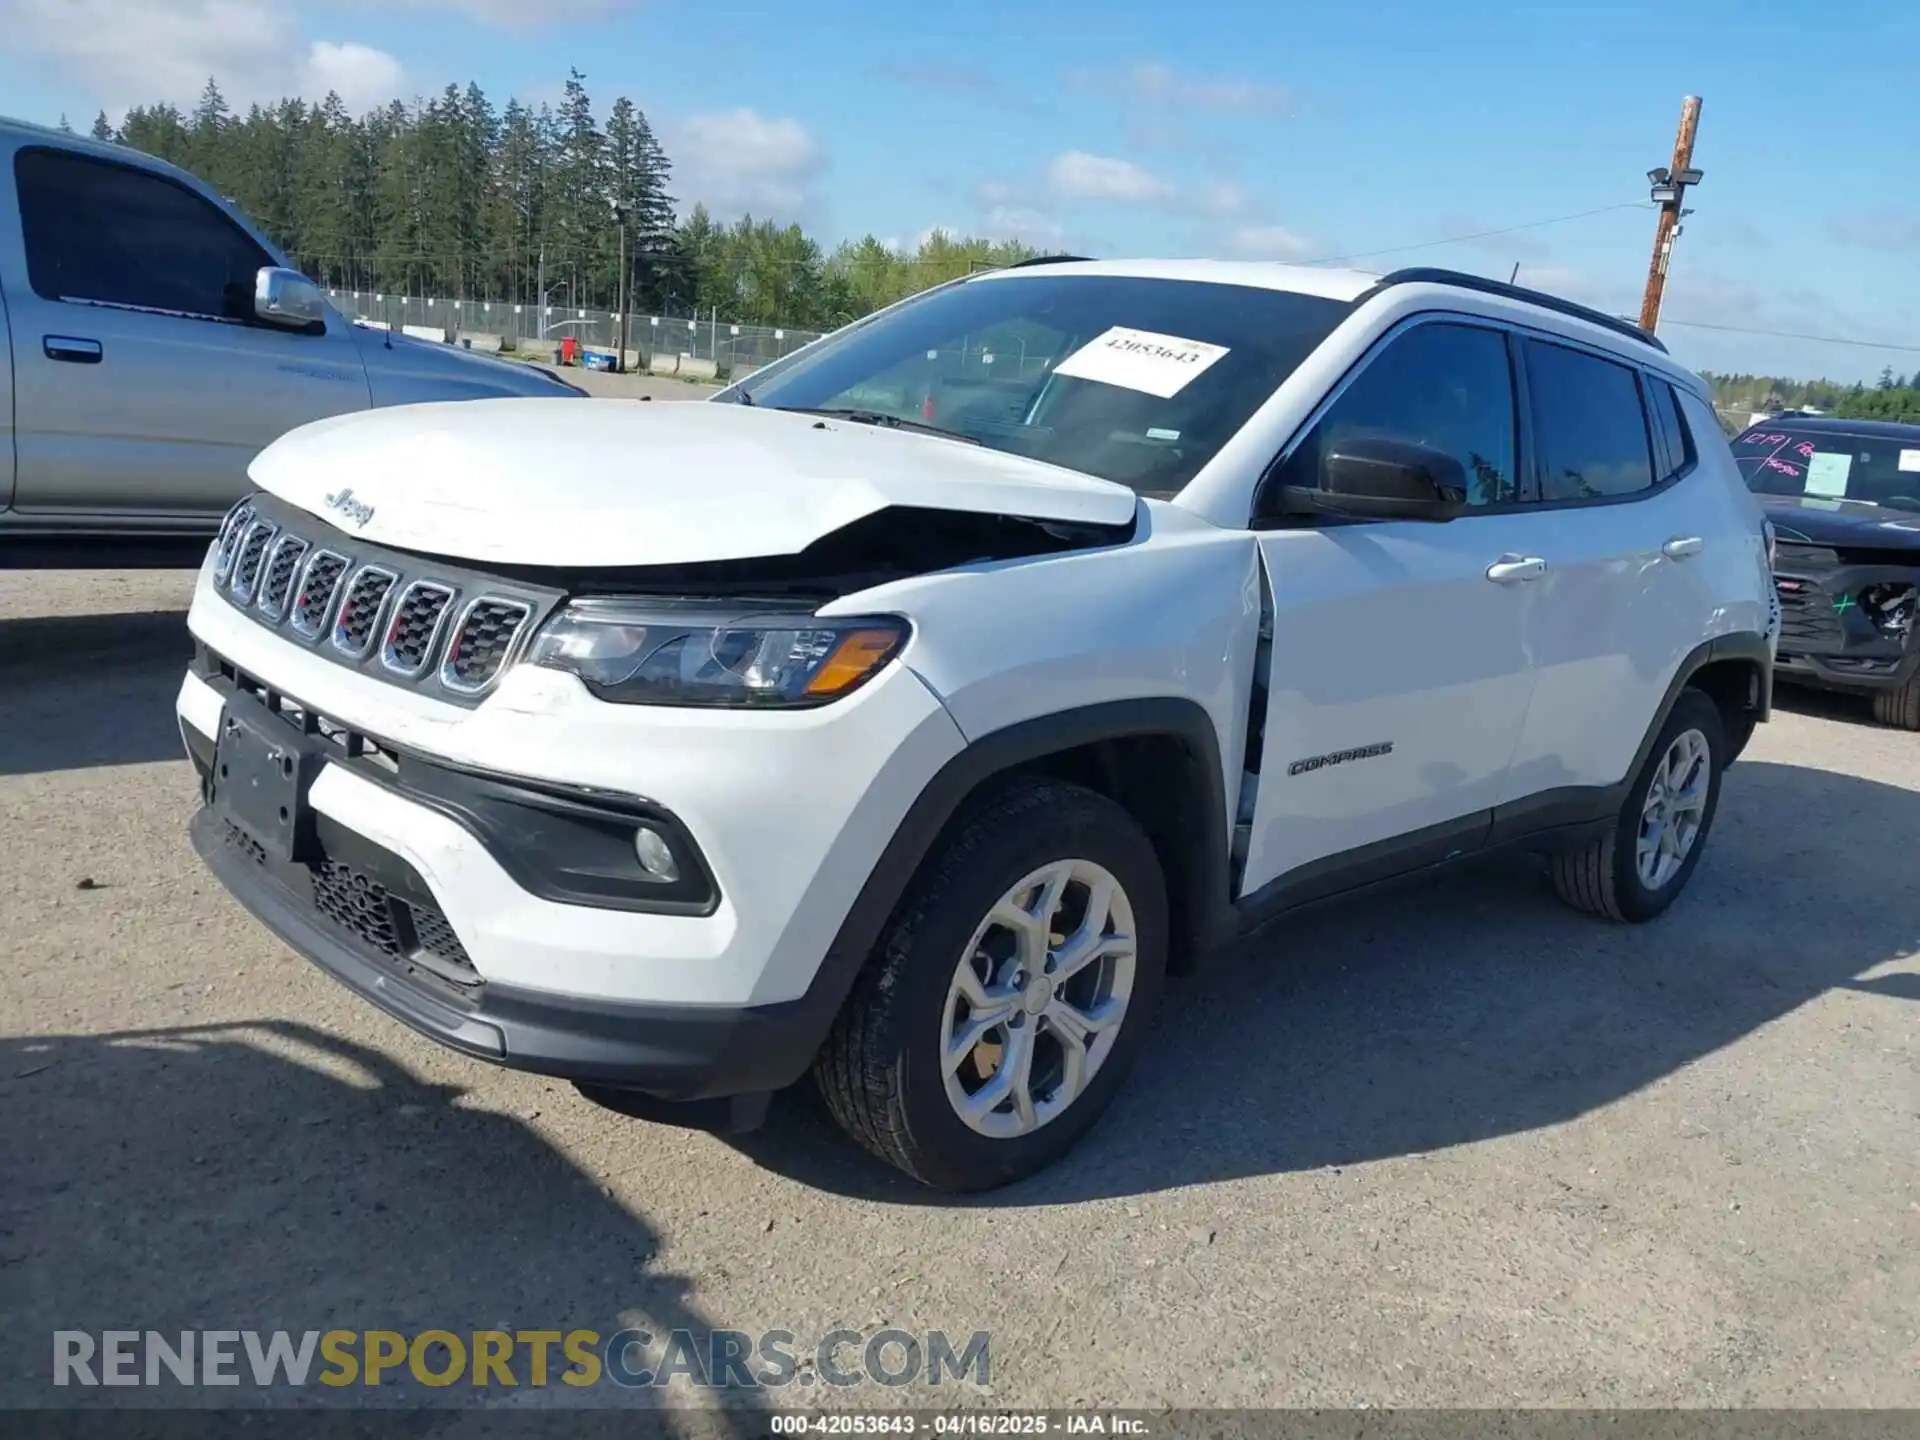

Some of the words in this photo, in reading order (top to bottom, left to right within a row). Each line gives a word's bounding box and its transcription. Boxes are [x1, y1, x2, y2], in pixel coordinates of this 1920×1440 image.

[1104, 339, 1200, 363] 42053643
[325, 488, 375, 529] Jeep
[1288, 741, 1394, 777] COMPASS
